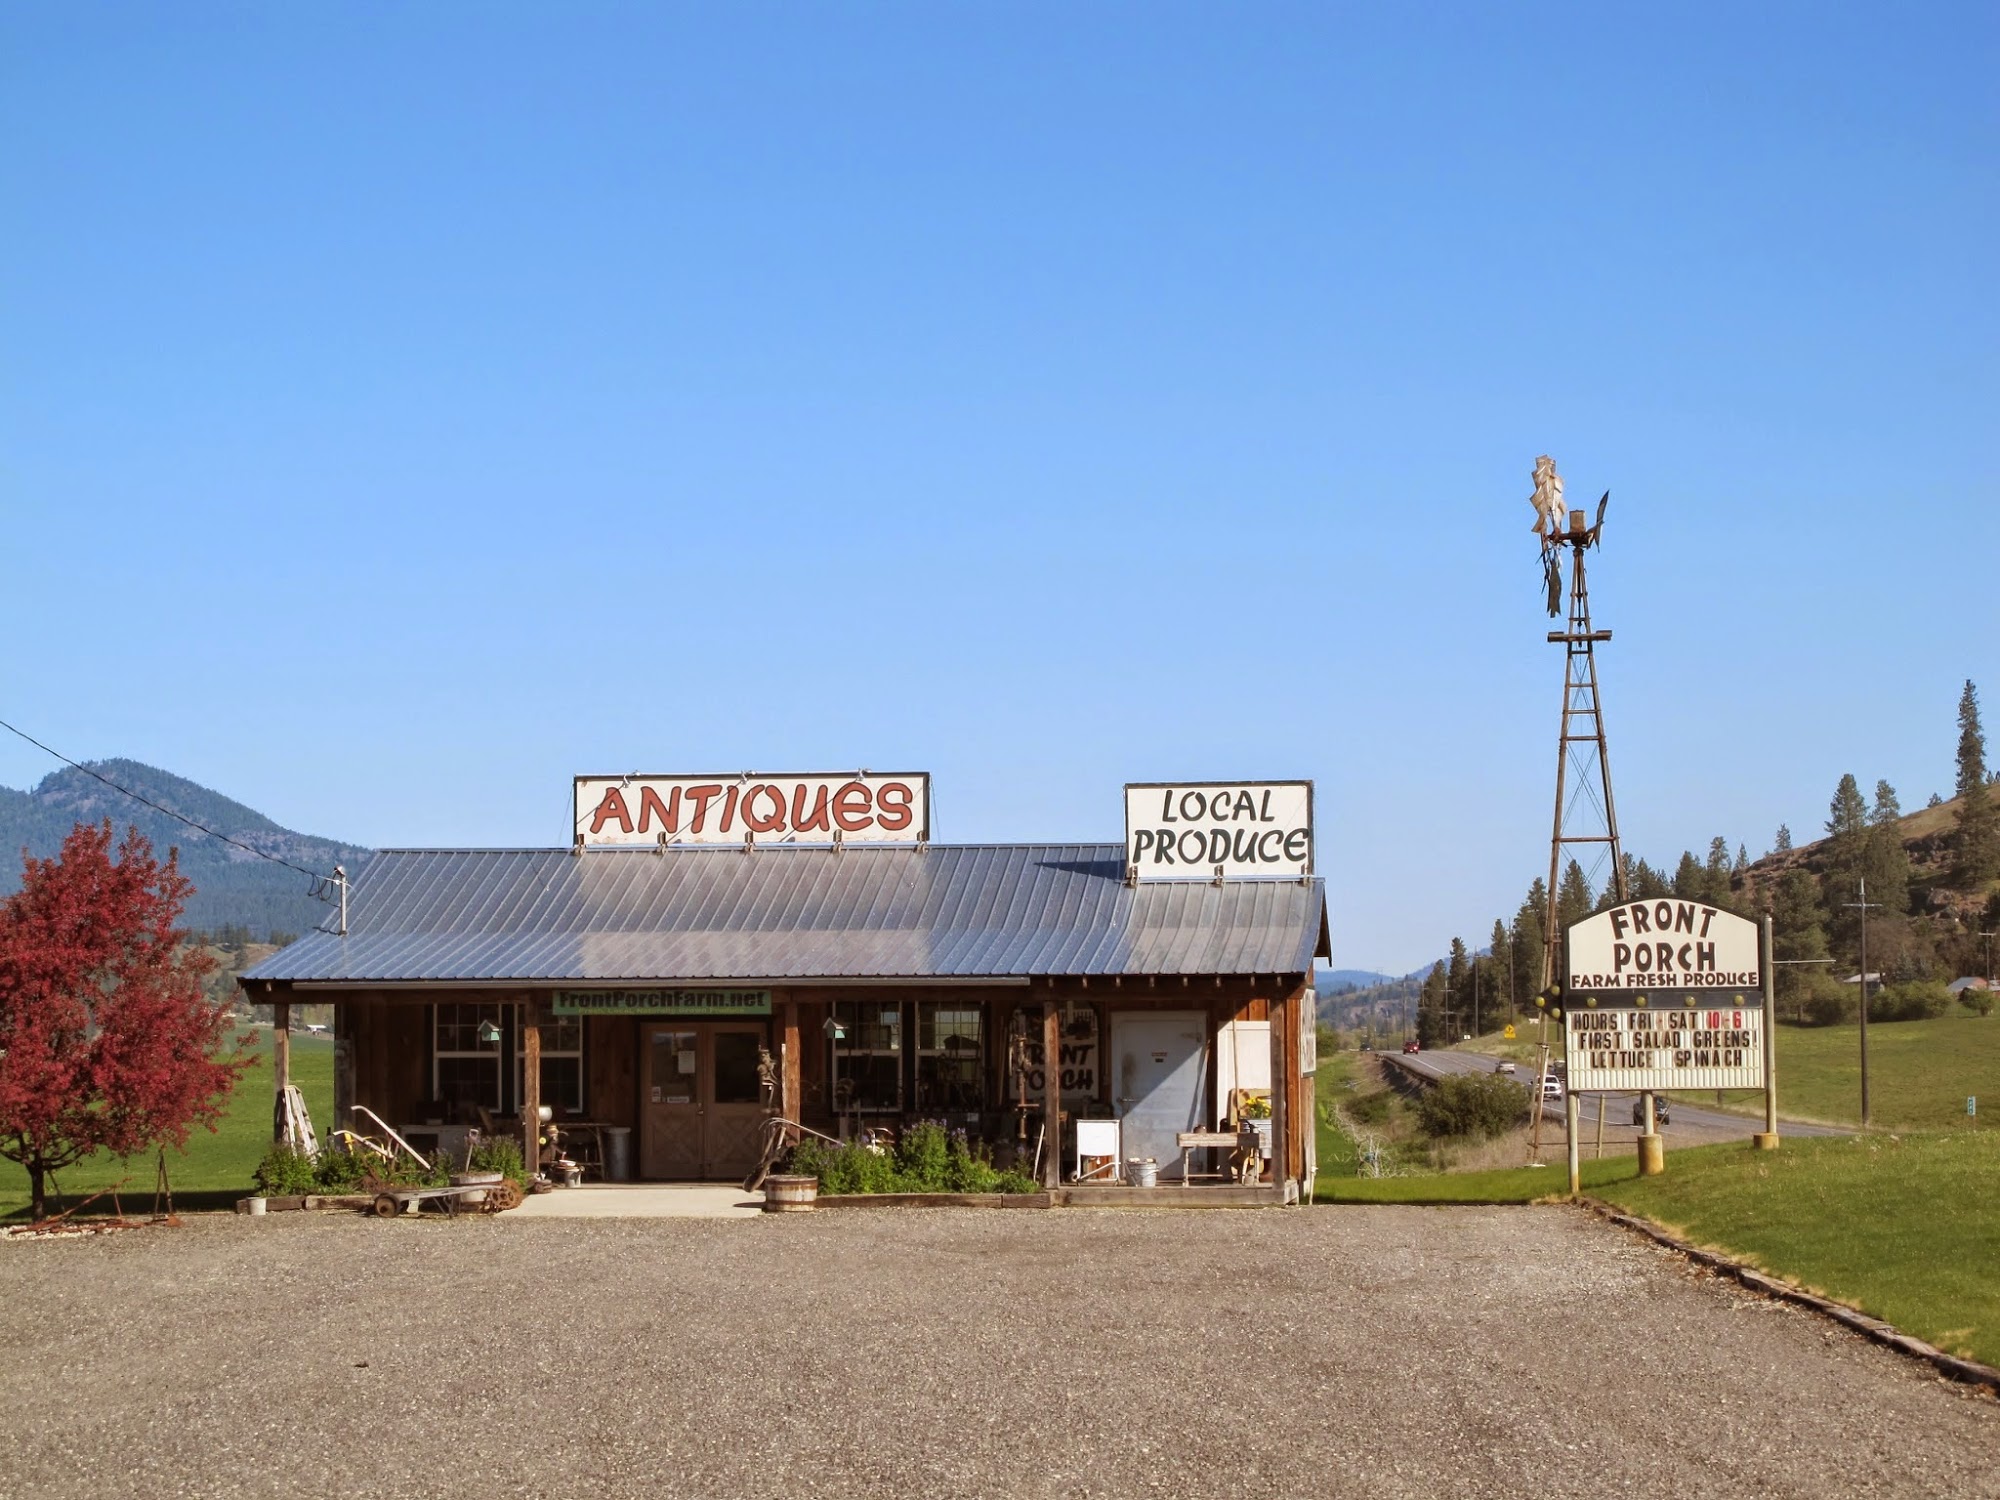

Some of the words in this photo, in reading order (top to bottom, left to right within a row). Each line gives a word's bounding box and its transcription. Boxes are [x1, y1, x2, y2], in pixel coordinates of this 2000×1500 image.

[589, 782, 913, 834] ANTIQUES
[1162, 789, 1275, 822] LOCAL
[1132, 828, 1310, 865] PRODUCE
[1609, 900, 1718, 940] FRONT
[1613, 941, 1716, 973] PORCH
[1571, 974, 1621, 988] FARM
[1626, 973, 1677, 987] FRESH
[1683, 972, 1757, 986] PRODUCE
[558, 991, 766, 1008] FrontPorchFarm.net
[1573, 1012, 1618, 1031] HOURS
[1629, 1012, 1651, 1030] FRI
[1669, 1012, 1698, 1029] SAT
[1579, 1032, 1622, 1050] FIRST
[1633, 1031, 1681, 1049] SALAD
[1693, 1030, 1758, 1048] GREENS!
[1591, 1051, 1653, 1069] LETTUCE
[1674, 1050, 1742, 1067] SPINACH
